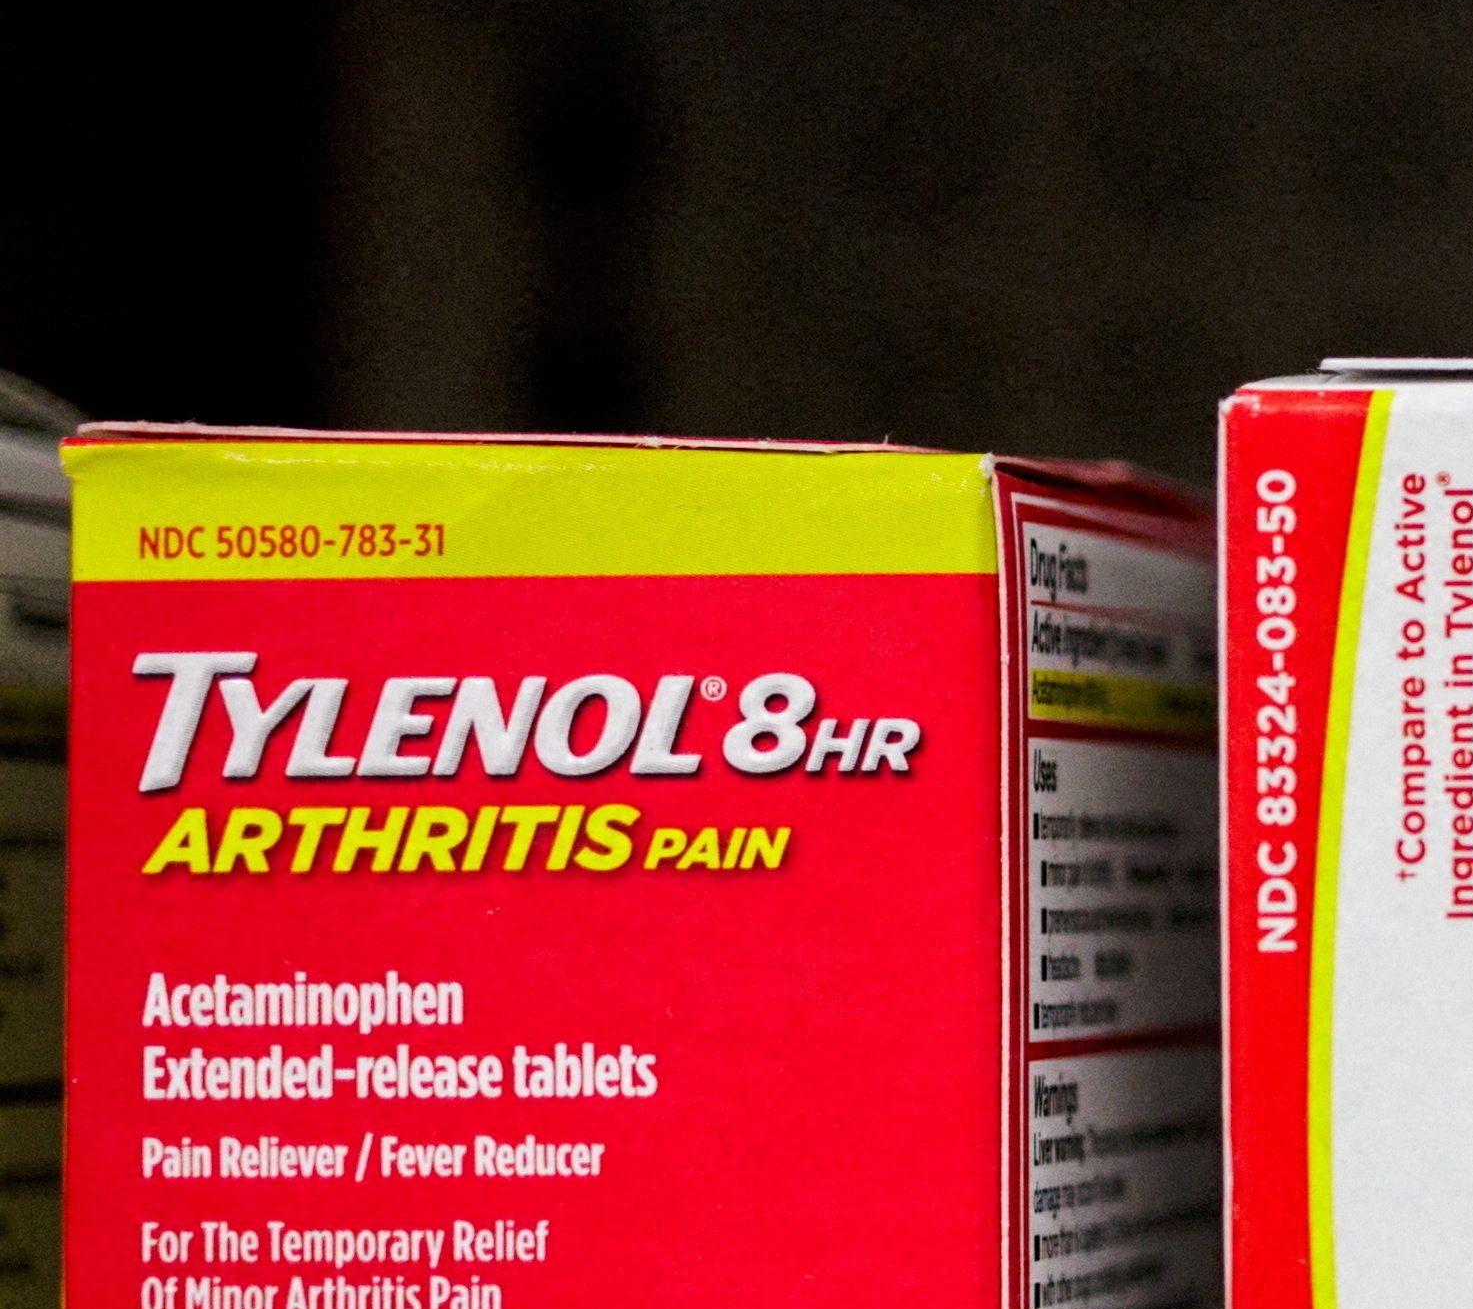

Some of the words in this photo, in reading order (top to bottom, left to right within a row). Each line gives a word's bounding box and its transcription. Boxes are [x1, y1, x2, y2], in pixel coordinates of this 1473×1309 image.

[139, 526, 205, 559] NDC
[217, 523, 444, 559] 50580-783-31
[1395, 474, 1426, 603] Active
[1257, 470, 1296, 825] 83324-083-50
[1397, 620, 1425, 661] to
[1444, 654, 1473, 687] in
[724, 673, 920, 773] 8HR
[143, 804, 640, 873] ARTHRITIS
[644, 828, 790, 869] PAIN
[1257, 842, 1296, 952] NDC
[143, 971, 463, 1035] Acetaminophen
[144, 1044, 503, 1099] Extended-release
[513, 1043, 657, 1097] tablets
[143, 1137, 211, 1178] Pain
[220, 1137, 348, 1178] Reliever
[381, 1136, 467, 1177] Fever
[474, 1135, 605, 1176] Reducer
